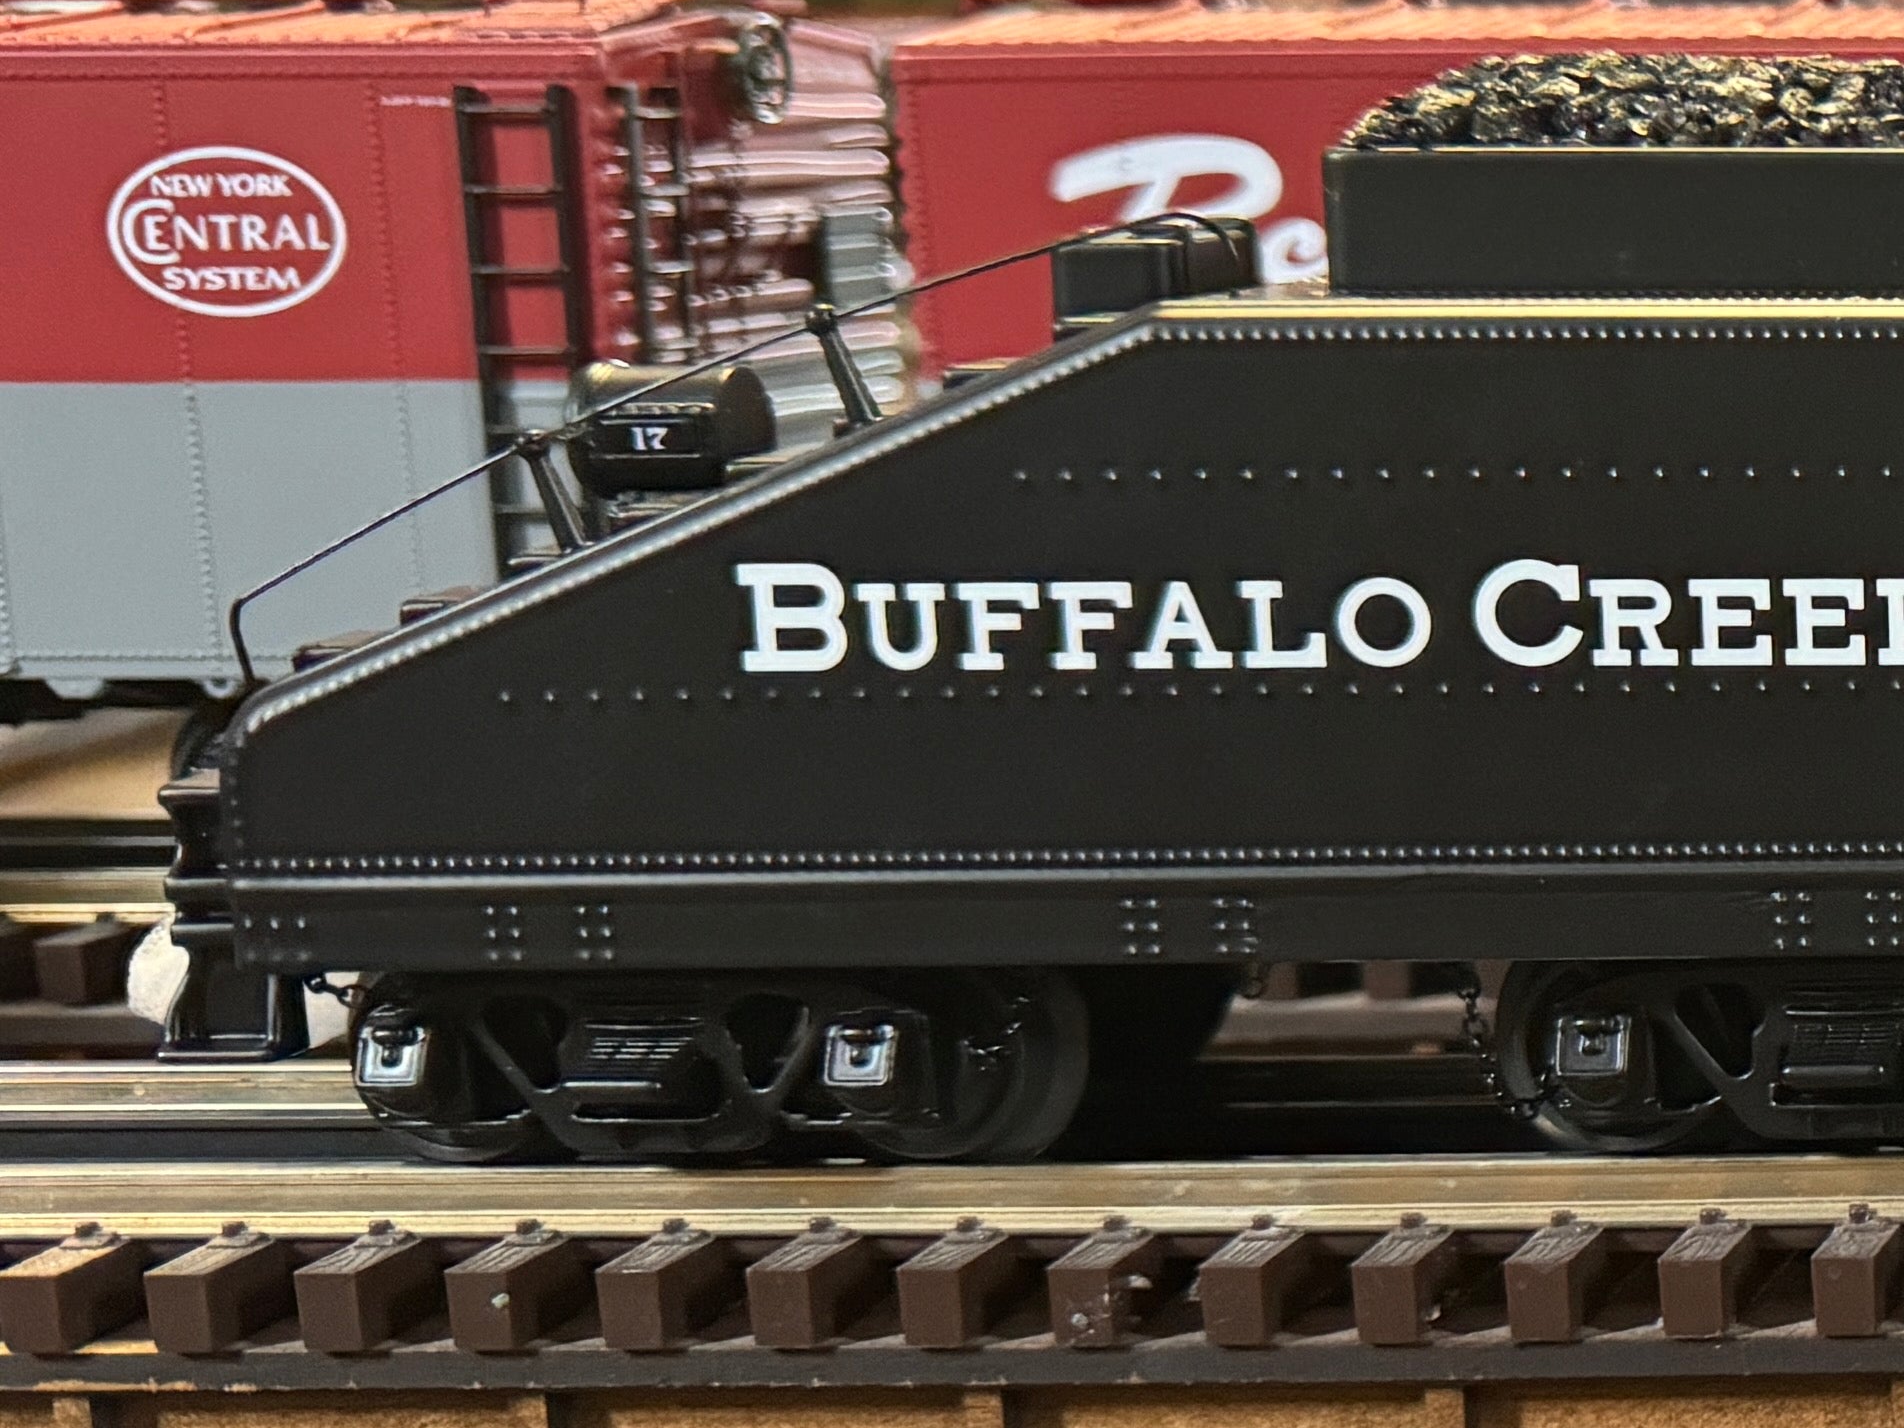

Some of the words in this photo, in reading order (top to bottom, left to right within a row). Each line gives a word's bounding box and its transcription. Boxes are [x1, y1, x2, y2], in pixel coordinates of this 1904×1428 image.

[151, 173, 213, 197] NEW
[219, 173, 293, 197] YORK
[122, 198, 331, 264] CENTRAL
[162, 266, 301, 291] SYSTEM
[630, 426, 668, 451] 17
[737, 563, 1431, 673] BUFFALO
